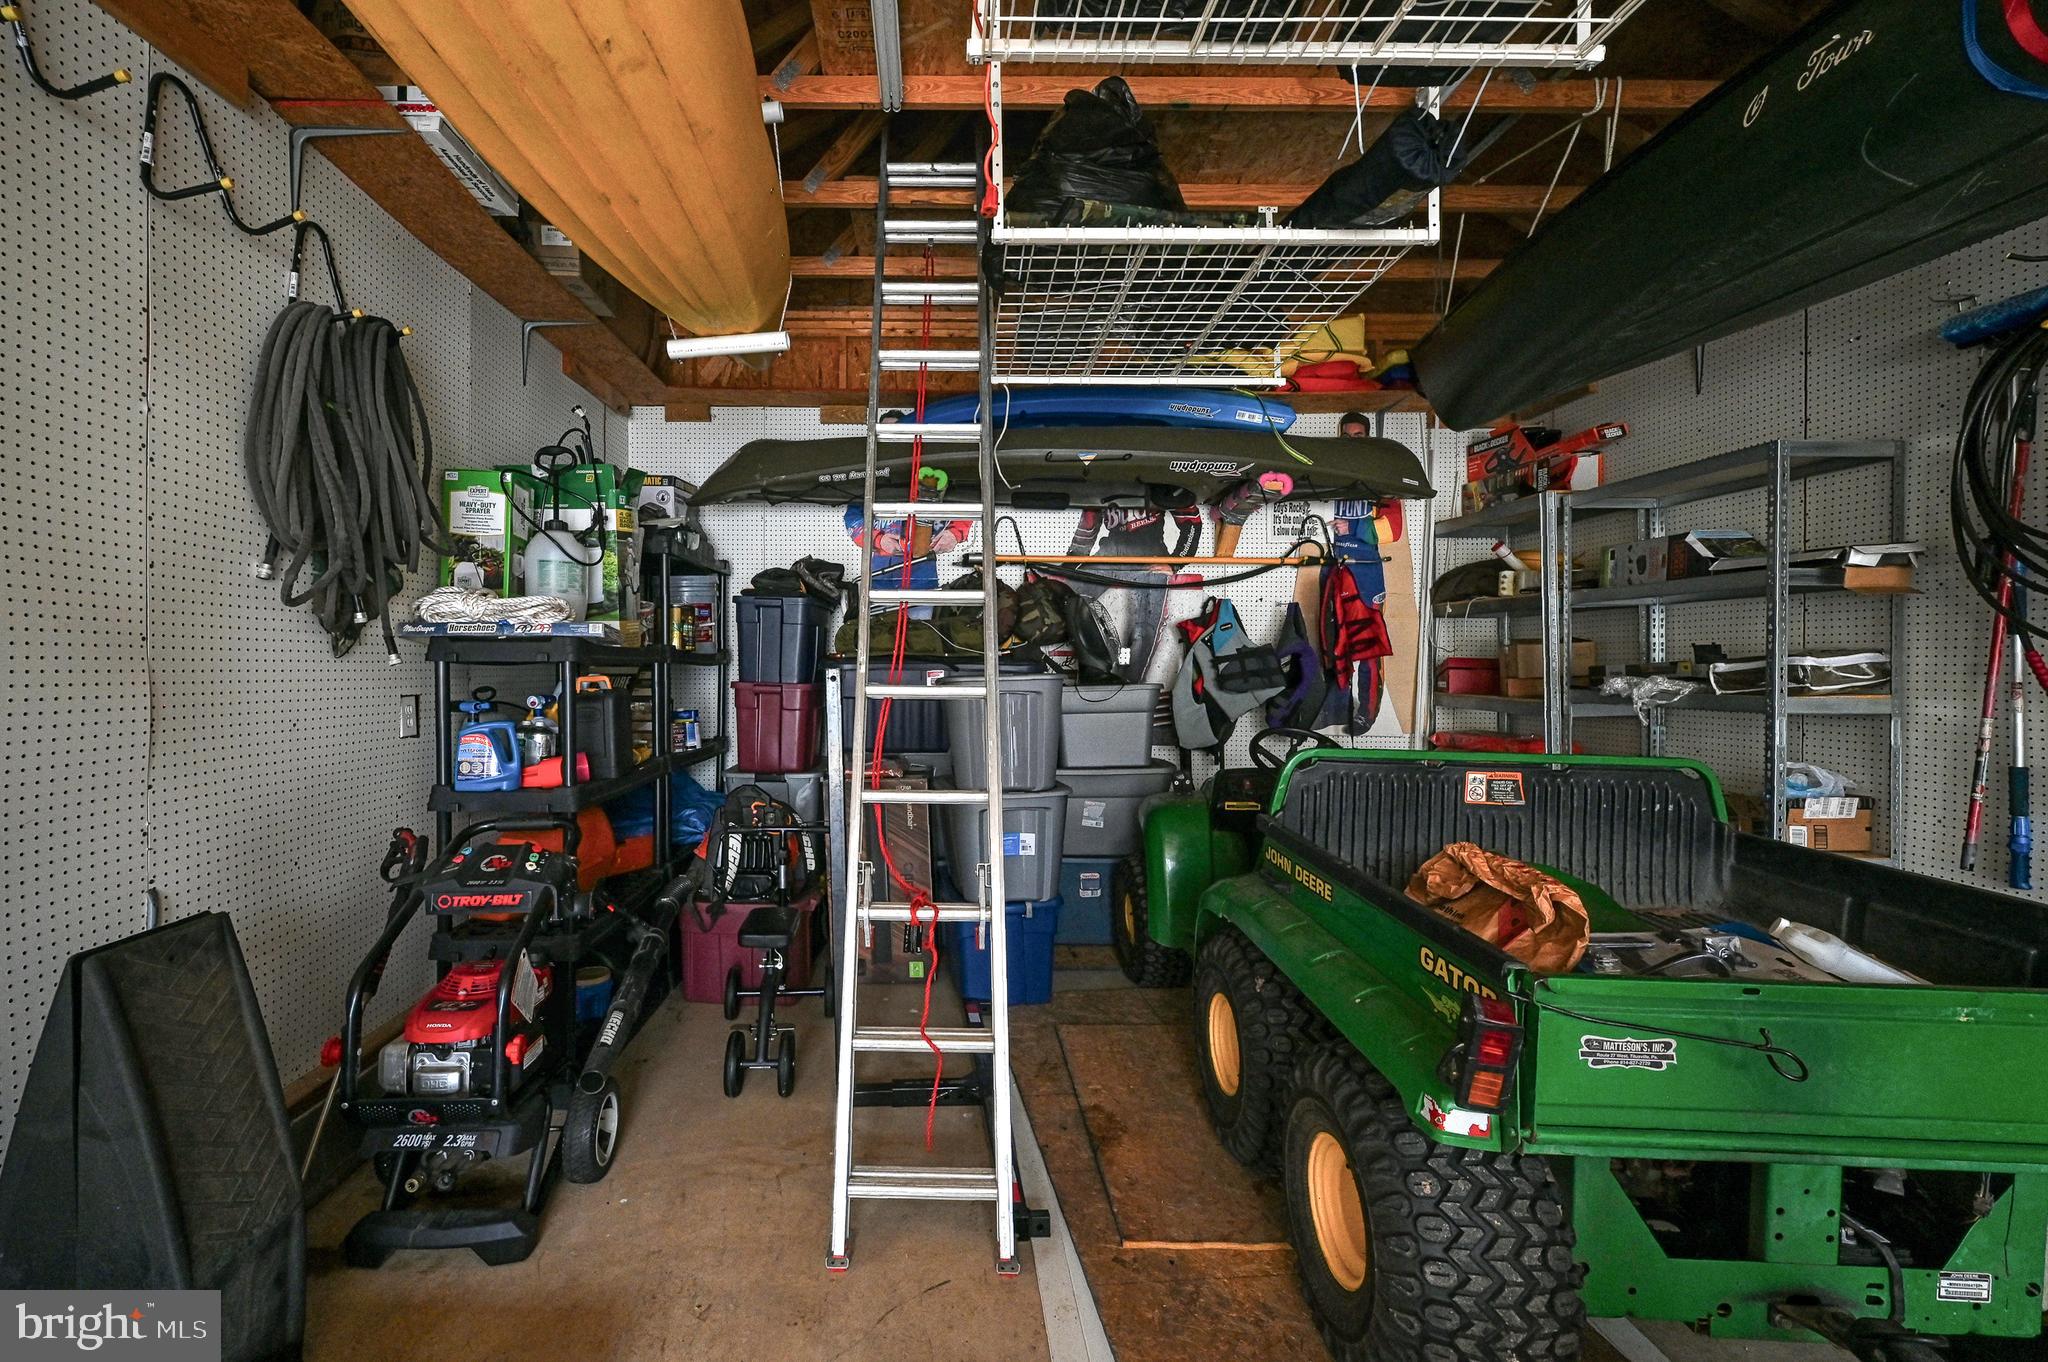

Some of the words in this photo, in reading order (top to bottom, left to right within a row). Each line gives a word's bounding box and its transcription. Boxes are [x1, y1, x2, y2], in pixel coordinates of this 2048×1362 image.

[1797, 29, 1876, 92] Town
[1169, 403, 1211, 414] sundolphin
[1169, 460, 1237, 473] sundolphin
[459, 500, 497, 509] HEAVY-DUTY
[465, 507, 491, 515] SPRAYER
[1273, 513, 1282, 525] It's
[1282, 513, 1292, 525] the
[1179, 524, 1196, 557] Budweiser
[402, 624, 436, 632] MacGregor
[447, 623, 497, 633] Horseshoes
[1265, 845, 1292, 875] JOHN
[1295, 864, 1333, 902] DEERE
[452, 893, 525, 907] TROY-BILT
[1652, 1043, 1667, 1053] INC.
[393, 1134, 423, 1147] 2600
[420, 1140, 431, 1148] PSI
[443, 1134, 463, 1147] 2.3
